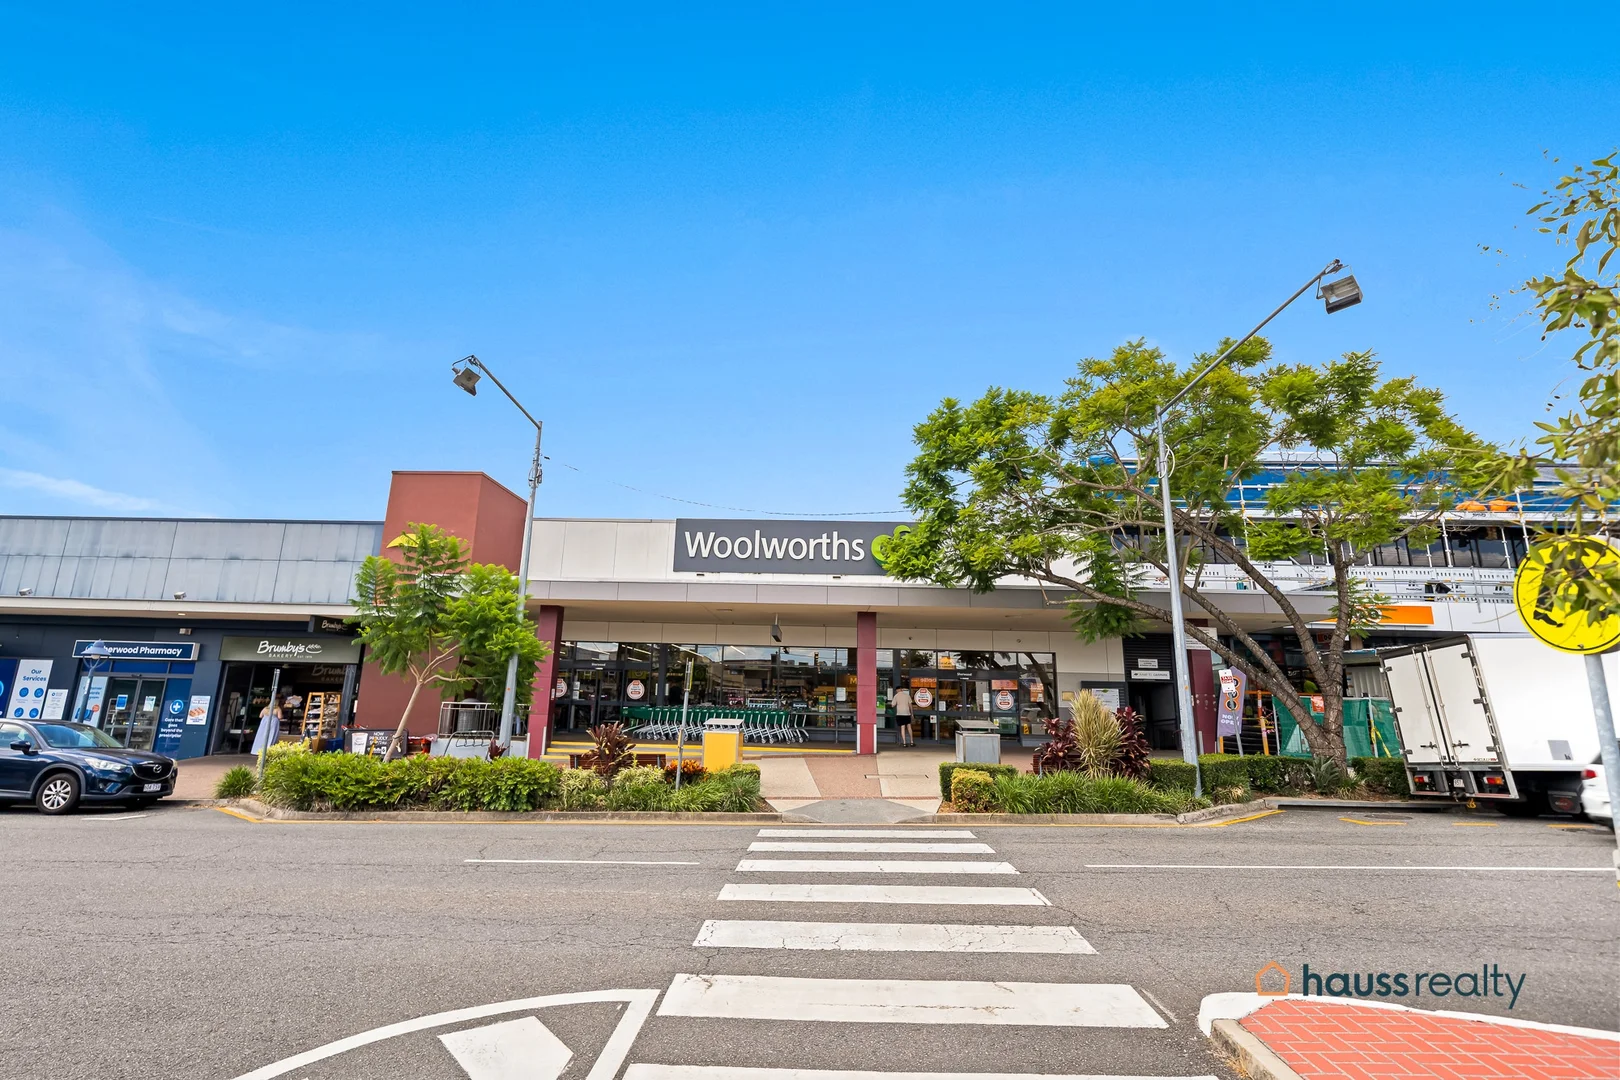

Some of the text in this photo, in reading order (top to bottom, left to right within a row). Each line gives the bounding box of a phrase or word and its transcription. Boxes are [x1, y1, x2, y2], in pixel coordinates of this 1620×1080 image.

[684, 529, 865, 562] Woolworths
[102, 645, 183, 657] herwood Pharmacy
[257, 640, 305, 656] Brumby's
